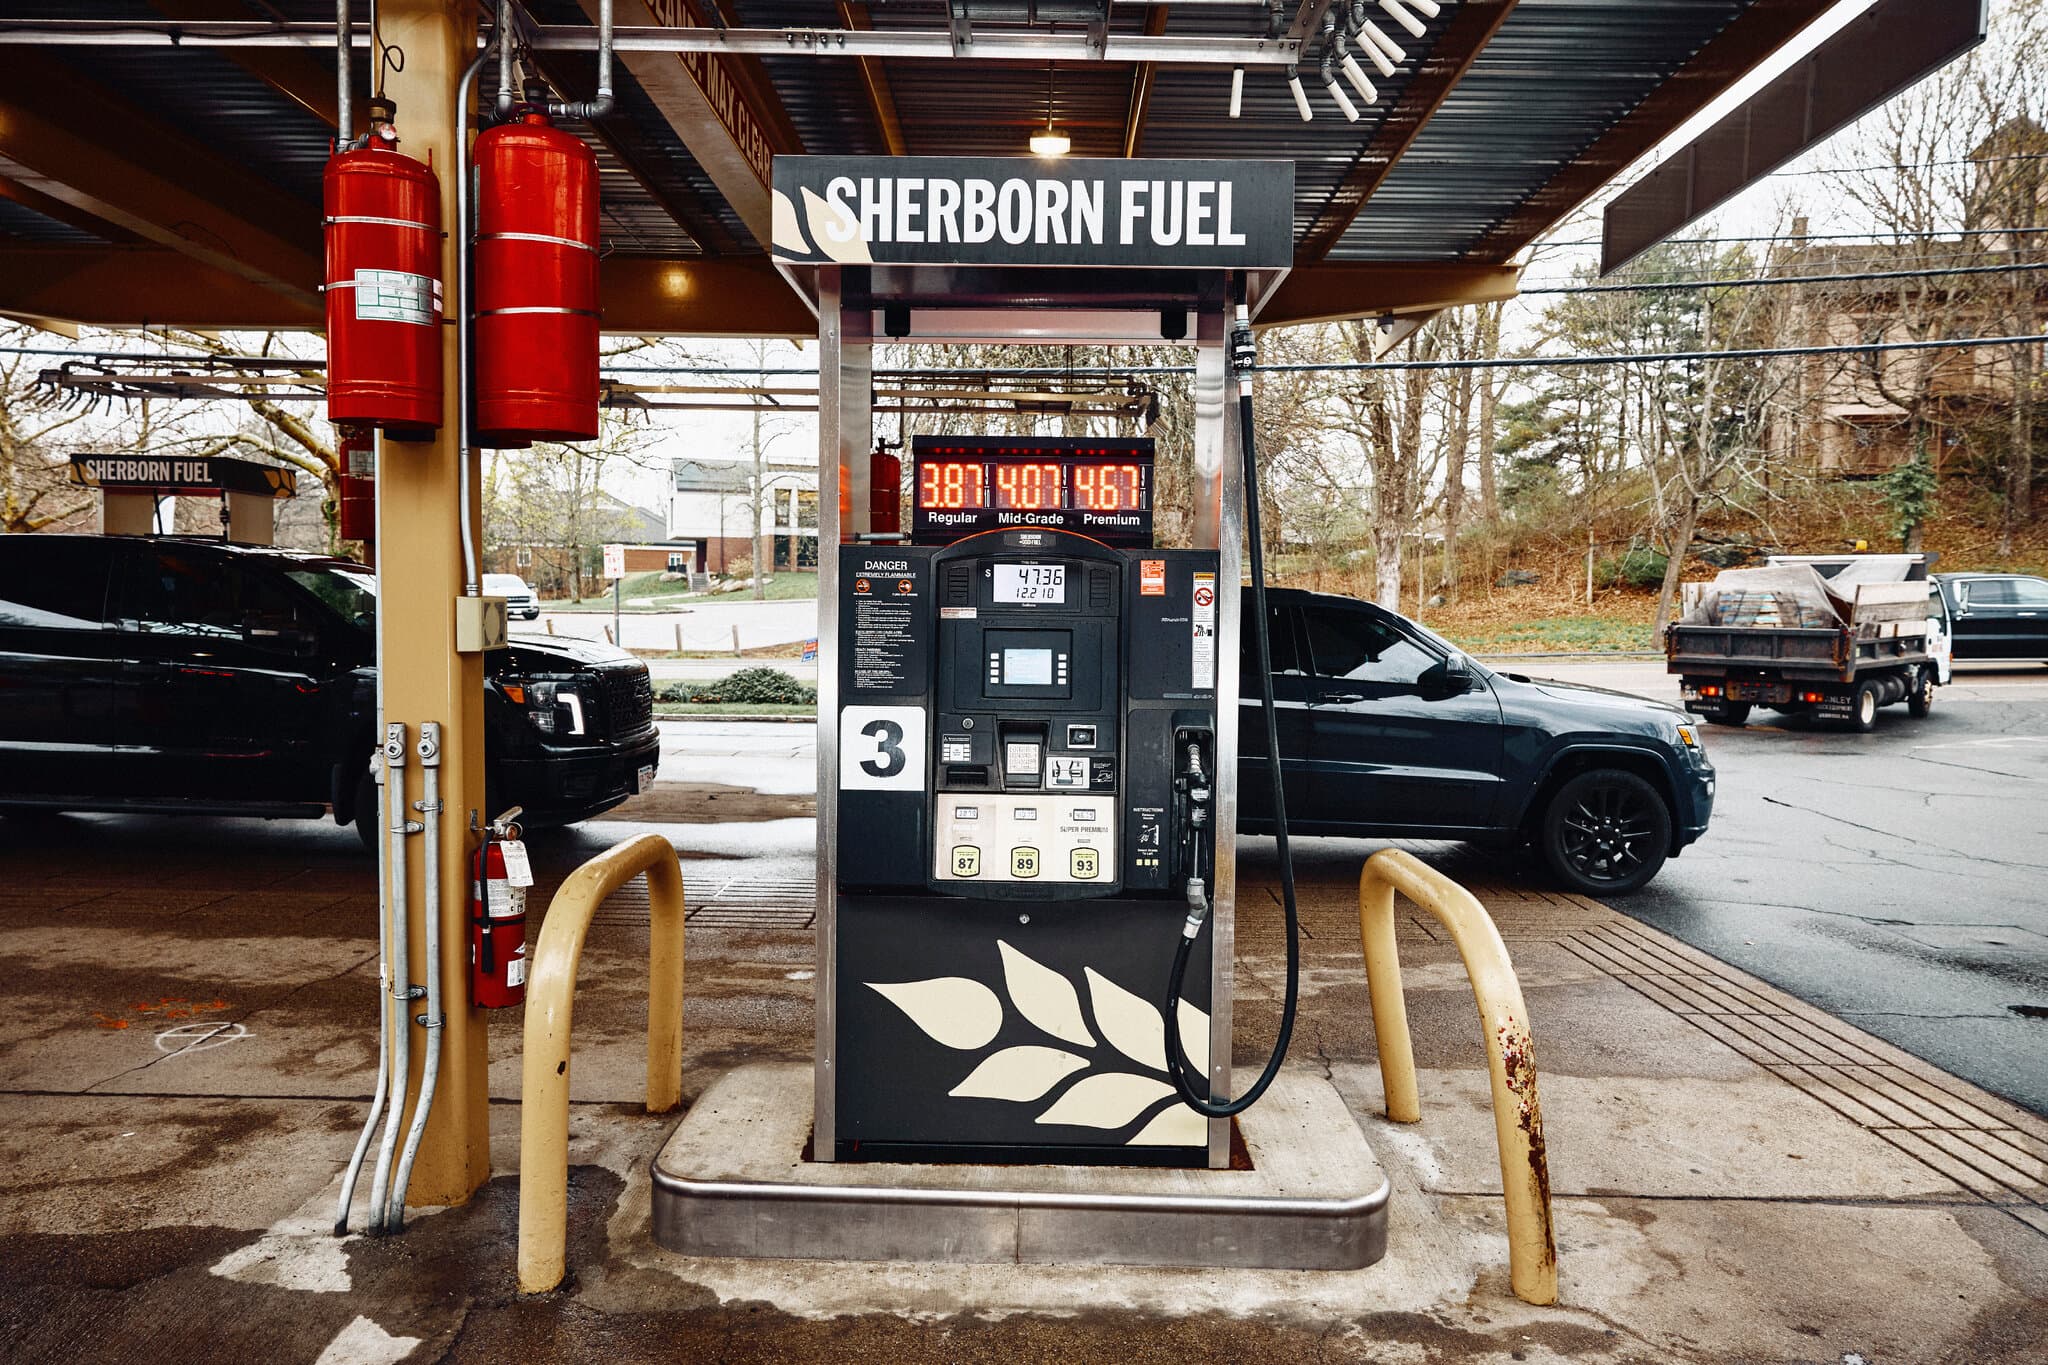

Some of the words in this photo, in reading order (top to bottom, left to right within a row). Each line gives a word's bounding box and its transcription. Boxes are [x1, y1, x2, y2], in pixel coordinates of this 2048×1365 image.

[707, 52, 735, 134] MAX
[826, 176, 1103, 243] SHERBORN
[1119, 180, 1245, 245] FUEL
[86, 460, 170, 482] SHERBORN
[174, 463, 213, 483] FUEL
[922, 463, 983, 509] 3.87
[997, 464, 1061, 509] 4.07
[1075, 466, 1139, 510] 4.67
[928, 512, 978, 526] Regular
[998, 512, 1064, 526] Mid-Grade
[1083, 514, 1141, 526] Premium
[864, 561, 908, 571] DANGER
[1019, 568, 1063, 586] 47.36
[1016, 587, 1055, 599] 12.210
[858, 719, 907, 778] 3
[958, 858, 976, 870] 87
[1016, 859, 1035, 870] 89
[1076, 861, 1094, 872] 93
